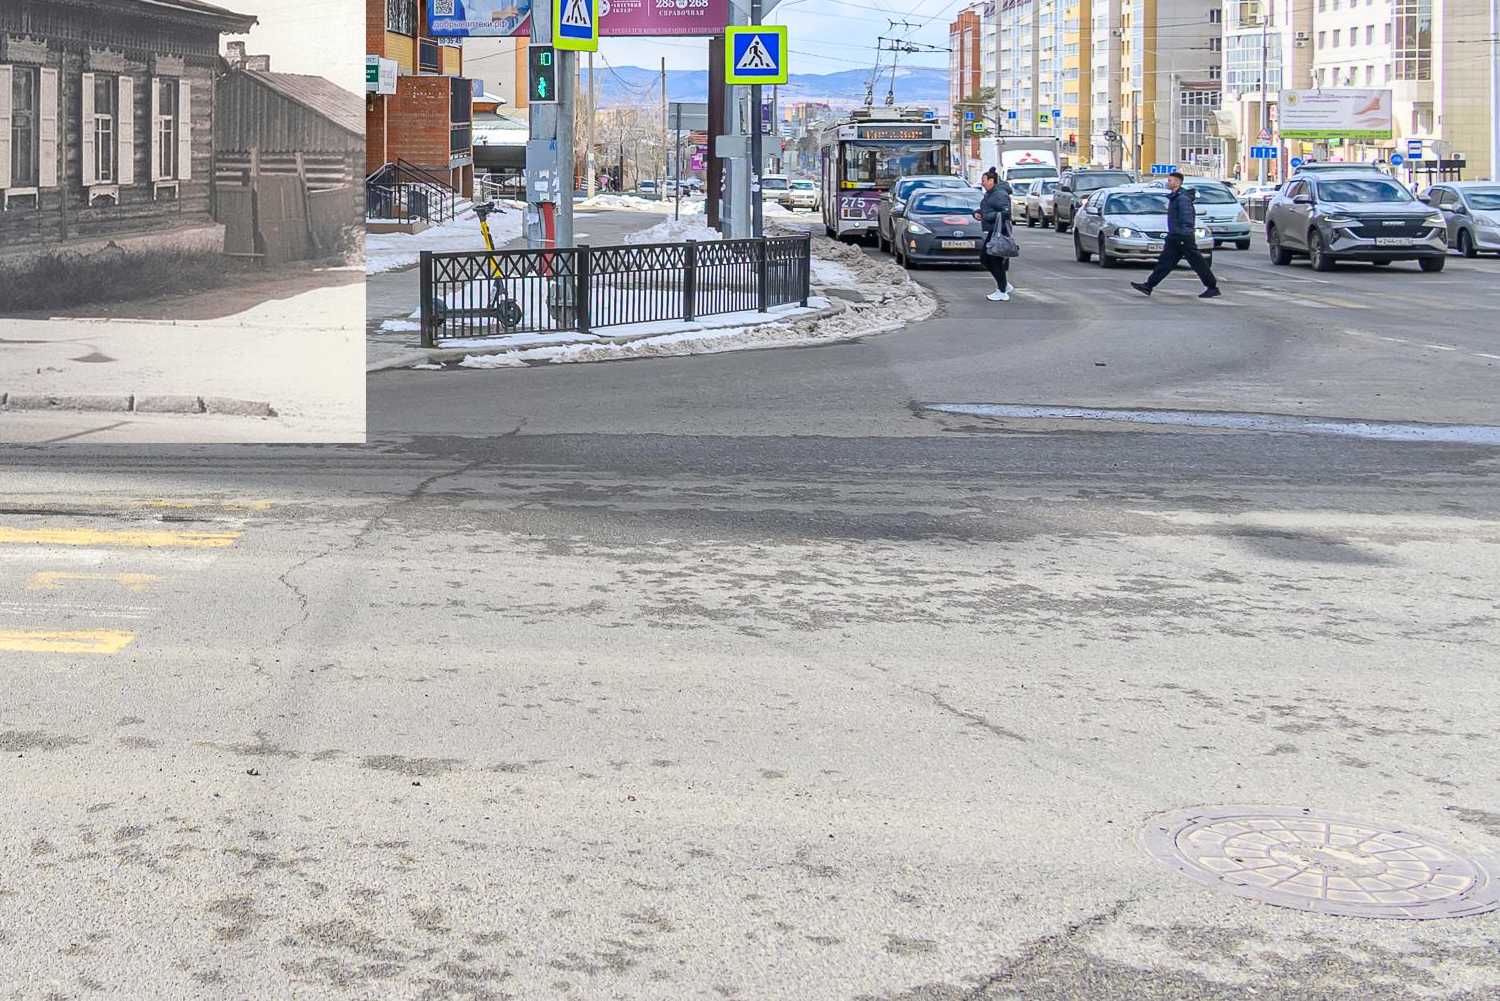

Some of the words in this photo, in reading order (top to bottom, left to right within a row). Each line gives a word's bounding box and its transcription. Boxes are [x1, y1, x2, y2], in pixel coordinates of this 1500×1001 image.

[433, 20, 508, 29] добрыеаптеки.рф
[541, 52, 551, 66] 10
[841, 197, 866, 208] 275
